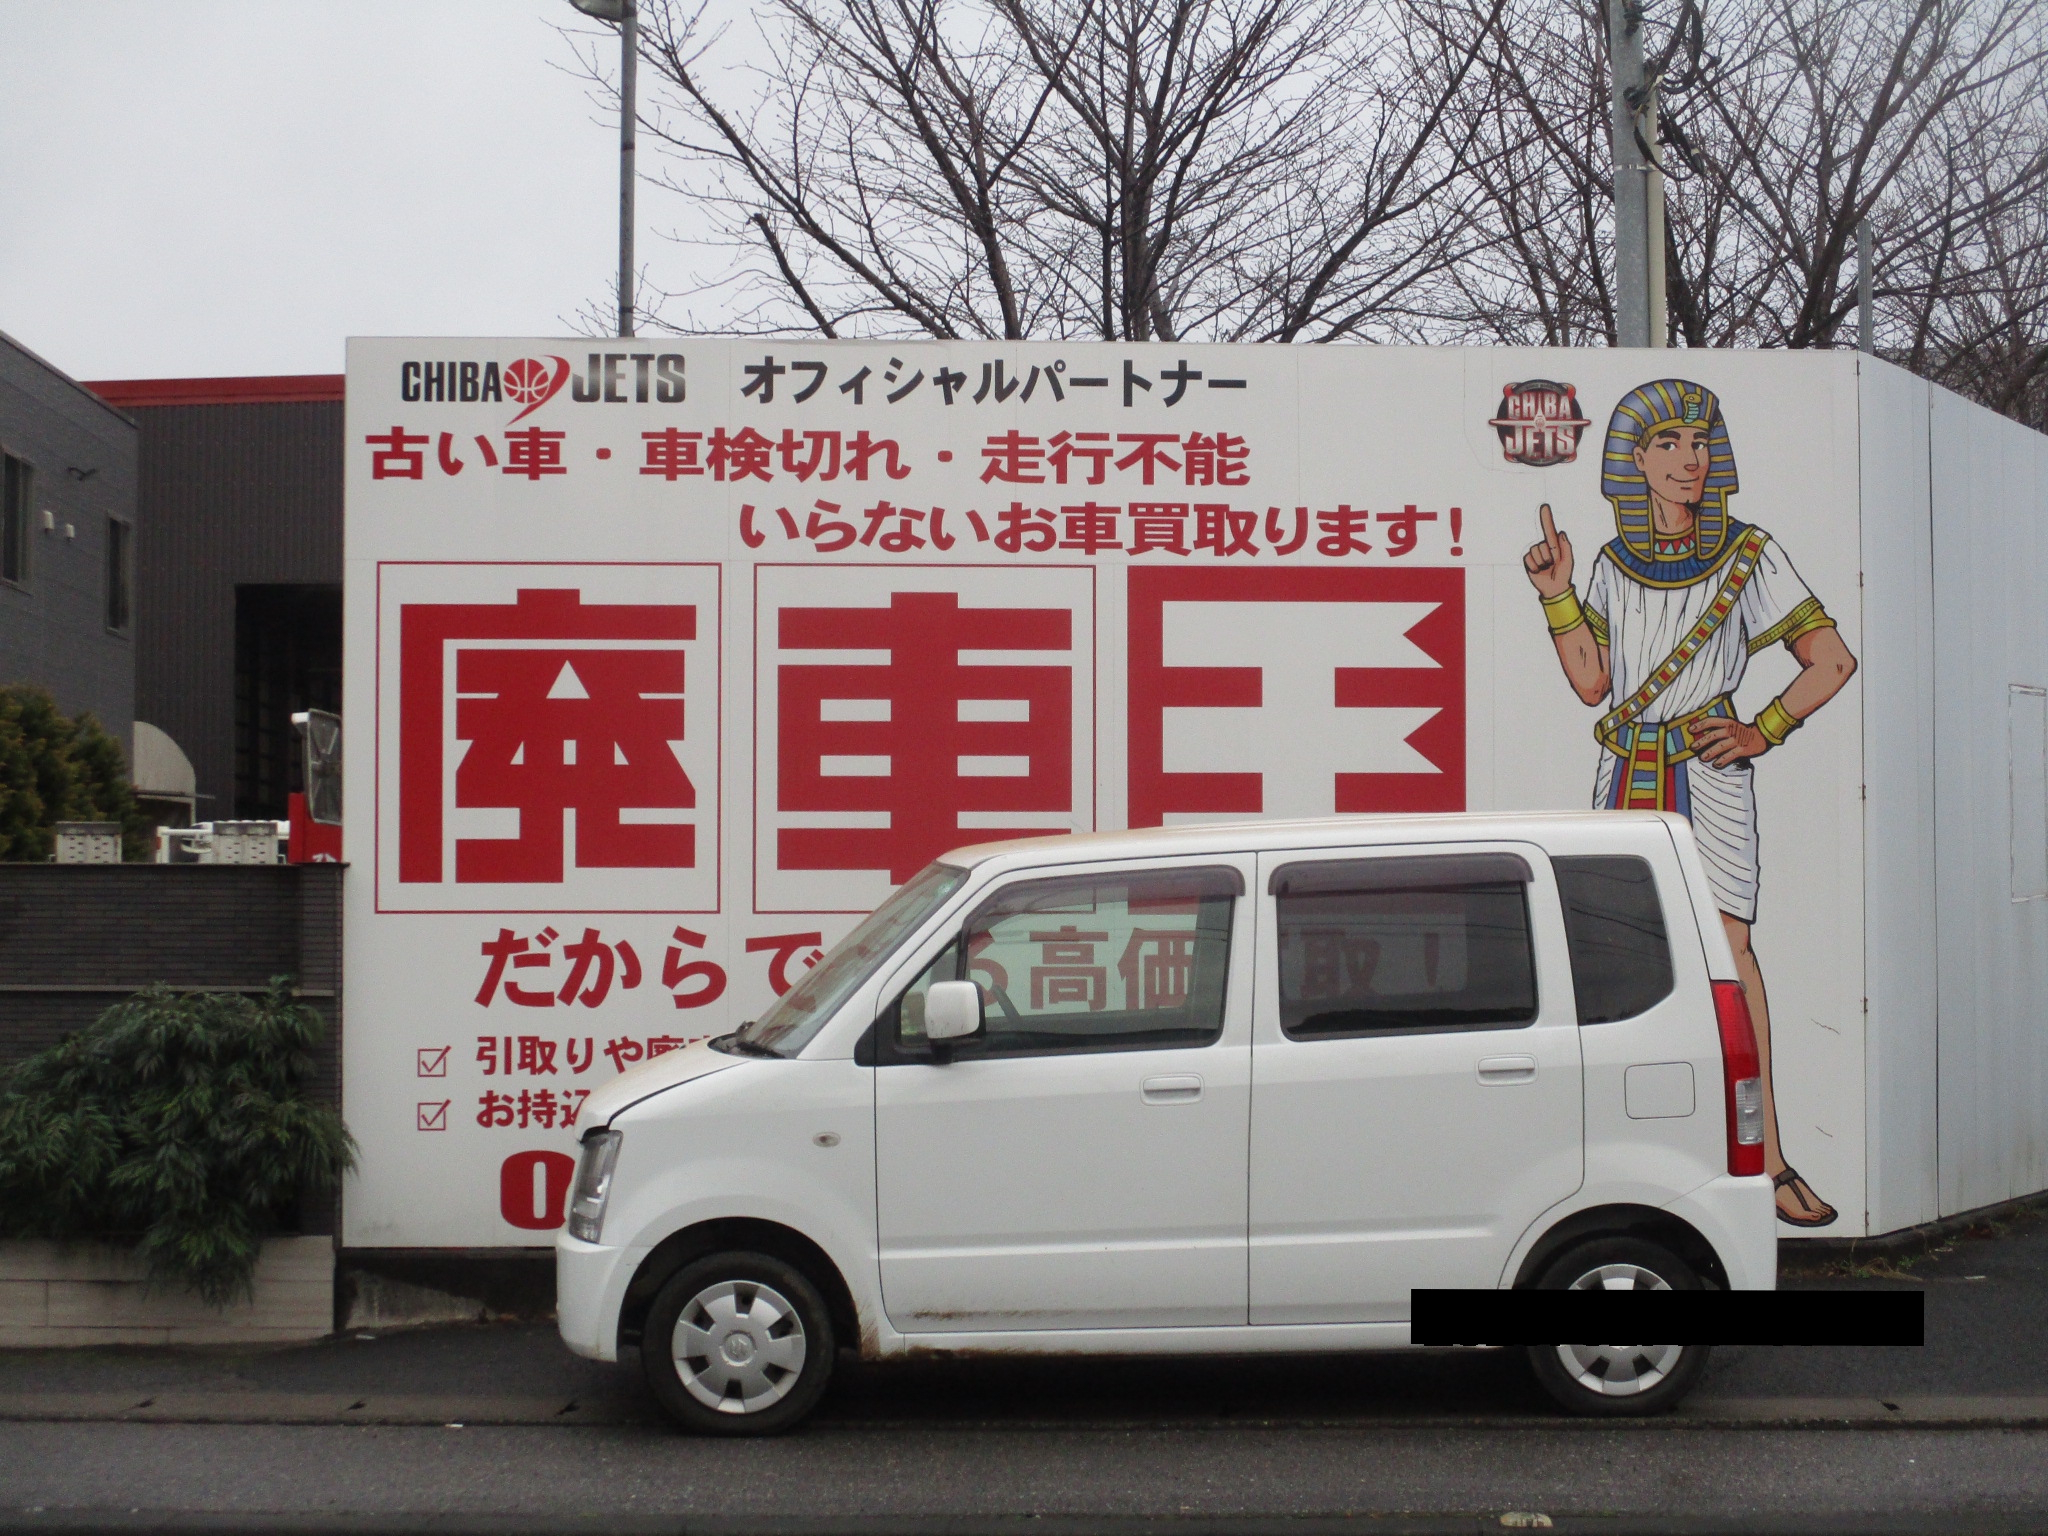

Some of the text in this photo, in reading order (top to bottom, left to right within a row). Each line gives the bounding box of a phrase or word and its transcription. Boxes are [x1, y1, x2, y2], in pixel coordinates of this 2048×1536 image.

[401, 353, 686, 404] CHIBA JETS
[740, 355, 1248, 408] オフィシャルパートナー
[1507, 390, 1573, 420] CHIBA
[1505, 424, 1575, 458] JETS
